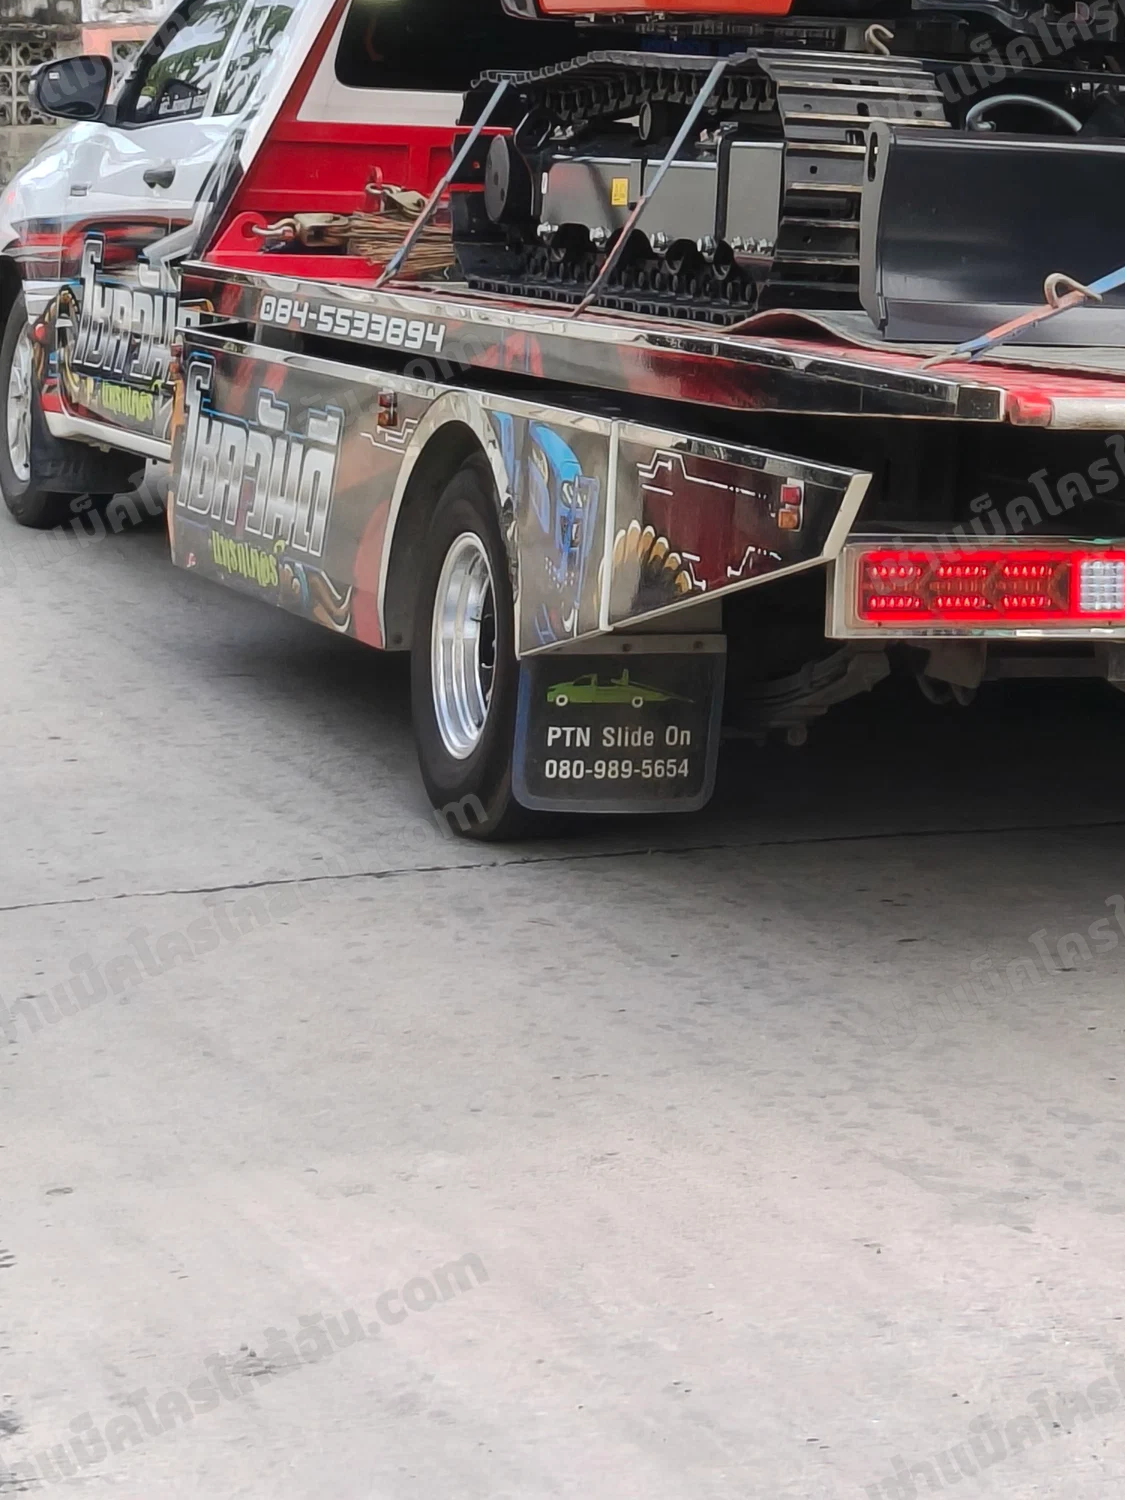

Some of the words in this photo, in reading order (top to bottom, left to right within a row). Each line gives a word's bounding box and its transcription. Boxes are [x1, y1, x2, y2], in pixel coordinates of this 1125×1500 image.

[259, 295, 446, 353] 084-5533894
[546, 726, 591, 747] PTN
[602, 726, 655, 748] Slide
[664, 725, 691, 746] On
[544, 758, 690, 780] 080-989-5654
